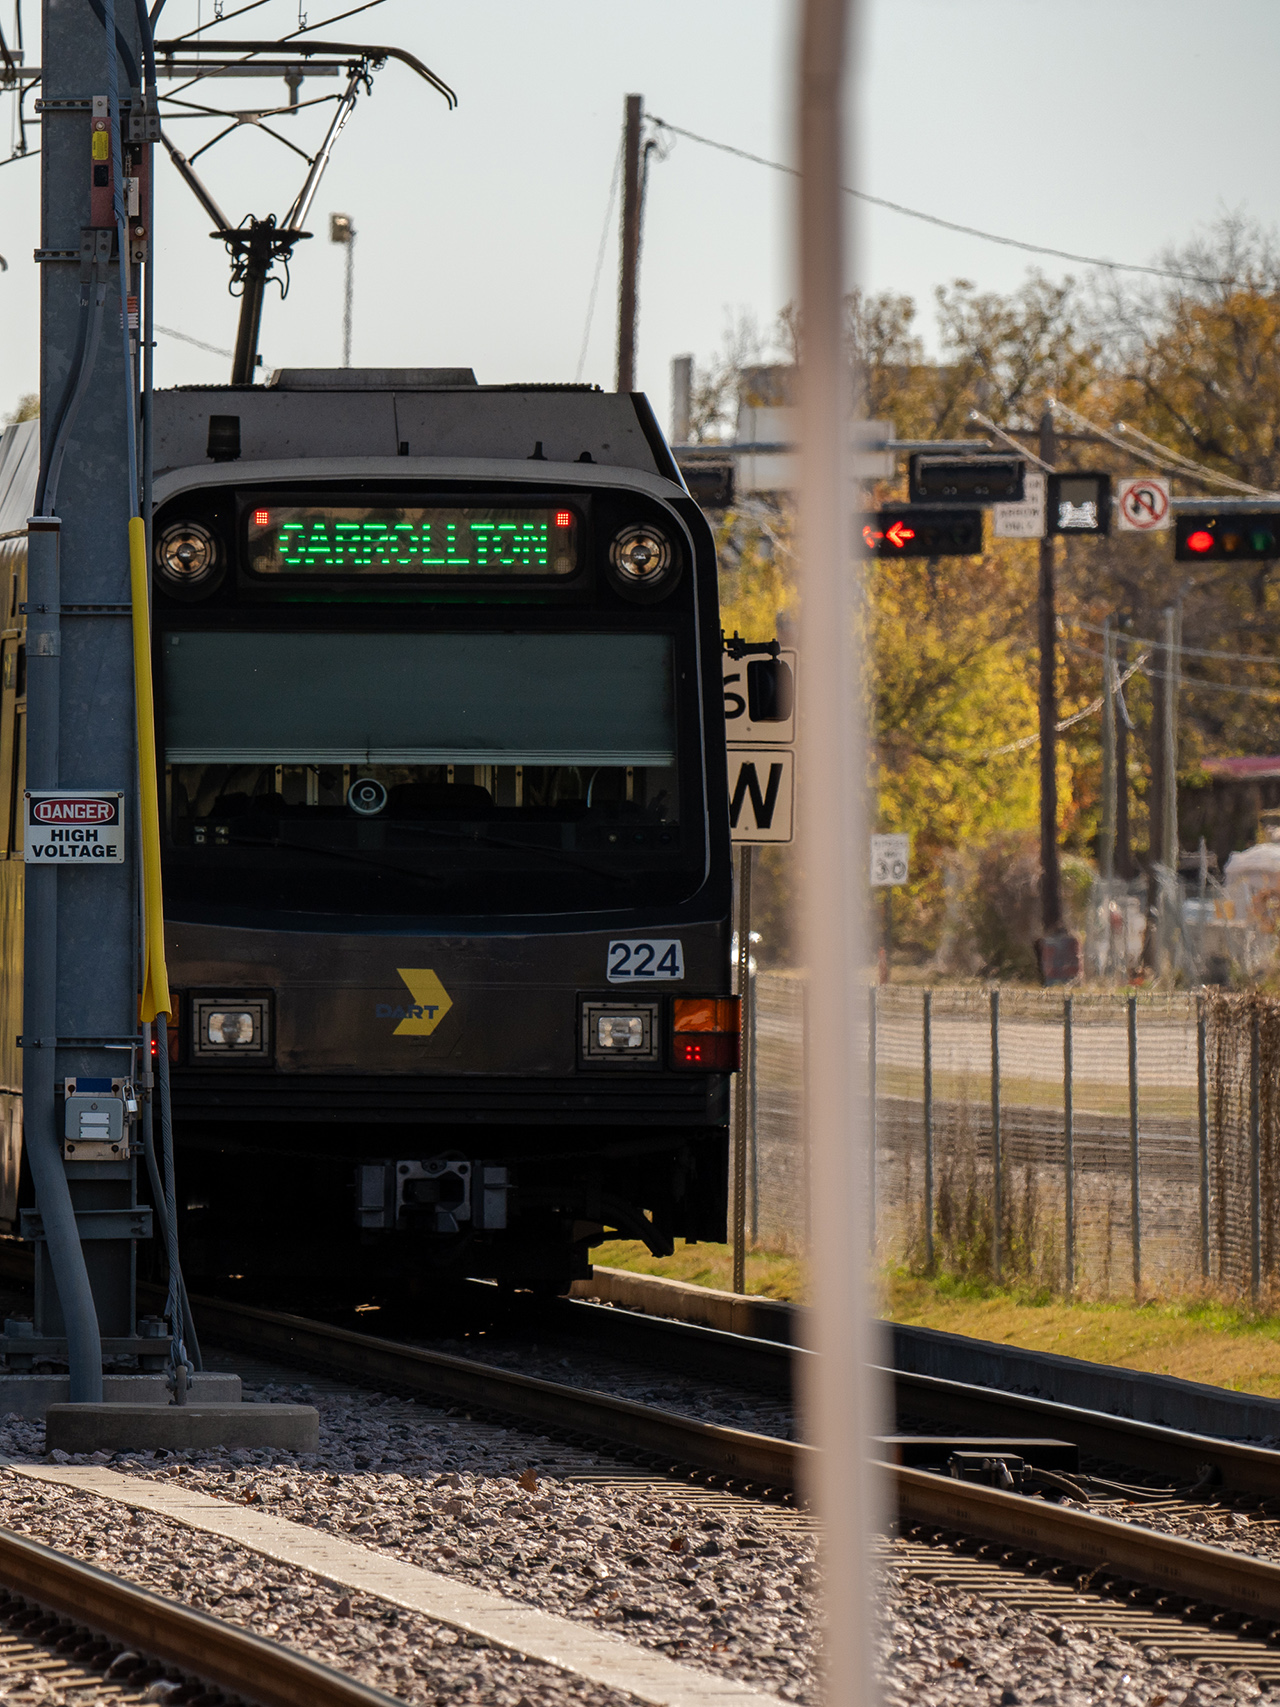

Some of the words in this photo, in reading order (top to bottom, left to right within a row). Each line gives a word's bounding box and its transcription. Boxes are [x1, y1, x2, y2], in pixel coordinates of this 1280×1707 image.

[729, 762, 784, 830] W
[39, 803, 110, 819] DANGER
[50, 828, 99, 842] HIGH
[31, 844, 118, 858] VOLTAGE
[609, 943, 681, 977] 224
[375, 1003, 440, 1020] DART
